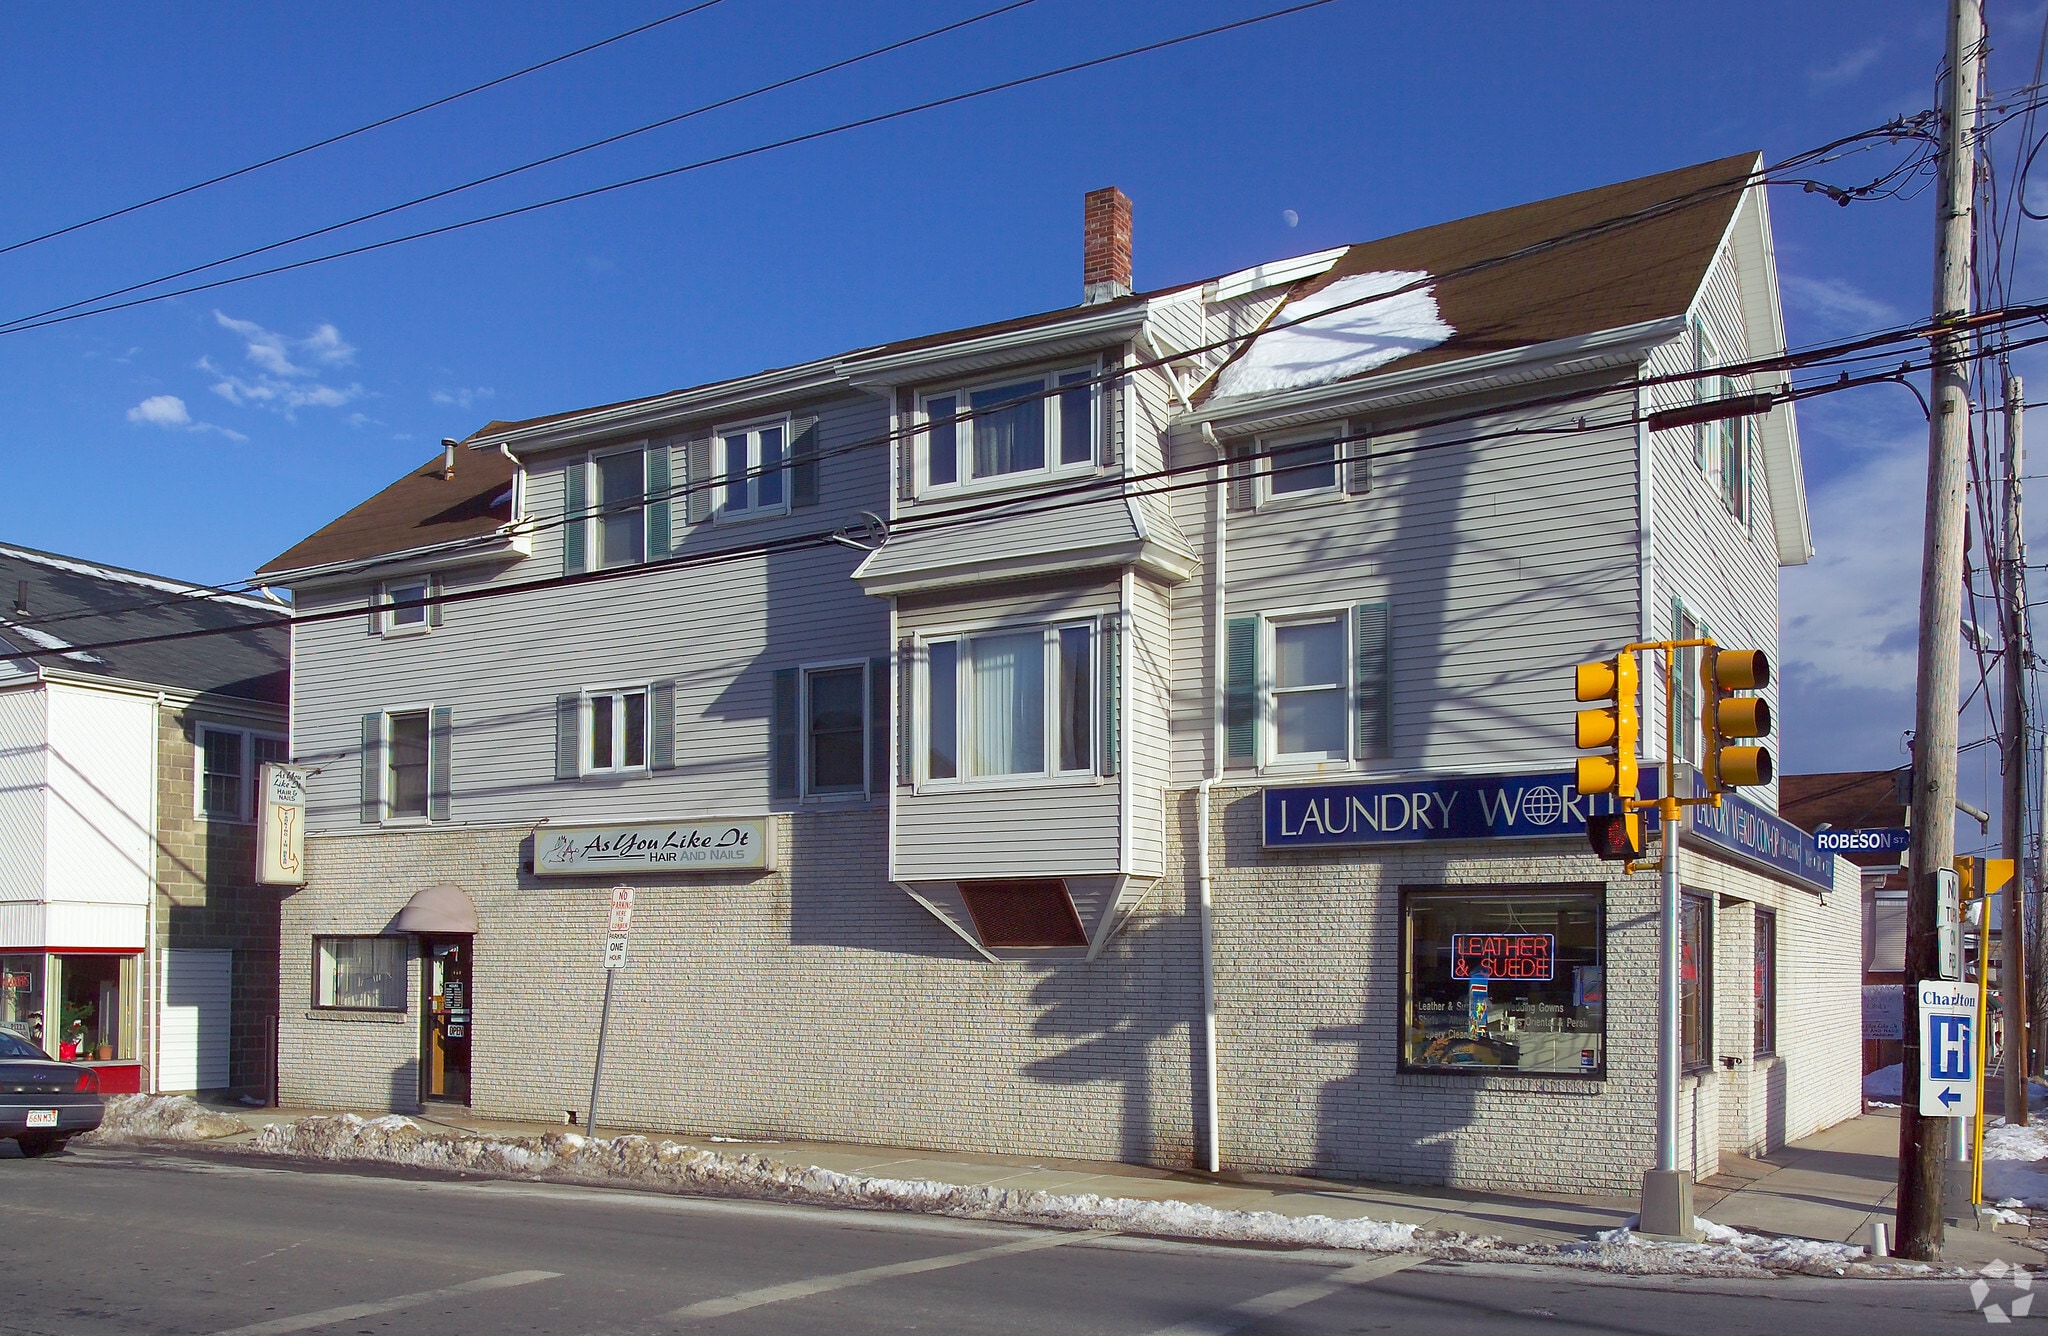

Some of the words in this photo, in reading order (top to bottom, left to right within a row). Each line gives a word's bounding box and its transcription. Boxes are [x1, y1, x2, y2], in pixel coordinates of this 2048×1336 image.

[276, 771, 285, 779] As
[274, 779, 290, 788] Like
[1281, 790, 1459, 836] LAUNDRY
[580, 834, 610, 858] As
[613, 832, 658, 856] You
[662, 830, 712, 849] Like
[714, 828, 749, 847] It
[1818, 833, 1891, 849] ROBESON
[649, 851, 677, 862] HAIR
[680, 850, 707, 861] AND
[709, 849, 745, 860] NAILS
[618, 891, 628, 900] NO
[610, 943, 624, 951] ONE
[1457, 937, 1548, 956] LEATHER
[1455, 958, 1469, 977] &
[1479, 958, 1549, 977] SUEDE
[1922, 991, 1976, 1008] Charlton
[1418, 1001, 1445, 1011] Leather
[1447, 1001, 1453, 1011] &
[1538, 1003, 1564, 1013] Gowns
[1525, 1017, 1553, 1027] Oriental
[1567, 1018, 1588, 1028] Persi
[449, 1026, 464, 1036] OPEN
[1940, 1022, 1964, 1073] H
